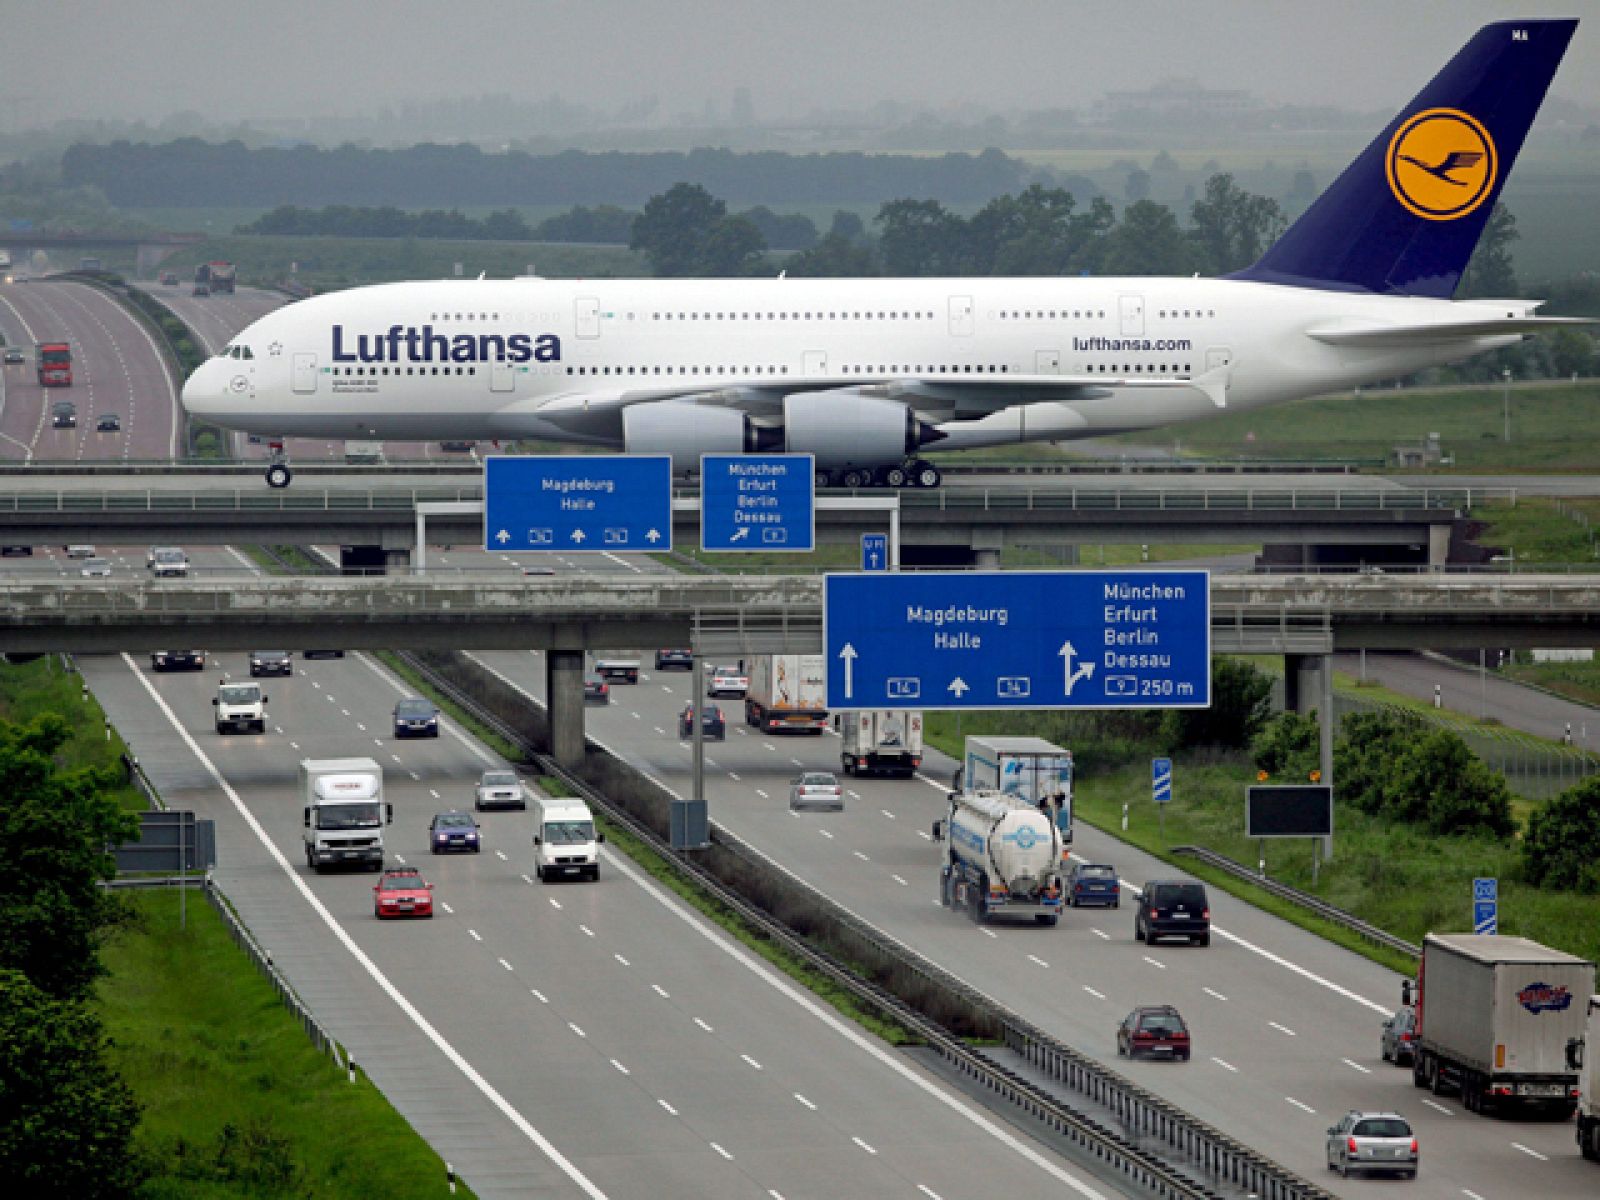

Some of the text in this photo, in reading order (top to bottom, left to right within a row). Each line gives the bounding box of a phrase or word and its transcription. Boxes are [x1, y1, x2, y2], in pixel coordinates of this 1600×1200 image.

[332, 325, 561, 362] Lufthansa
[1073, 337, 1191, 350] lufthansa.com
[730, 463, 786, 476] München
[542, 479, 614, 492] Magdeburg
[738, 479, 776, 491] Erfurt
[561, 499, 596, 510] Halle
[738, 495, 778, 507] Berlin
[735, 510, 781, 523] Dessau
[1104, 583, 1186, 599] München
[907, 605, 1009, 624] Magdeburg
[1104, 605, 1158, 622] Erfurt
[934, 632, 981, 648] Halle
[1104, 628, 1159, 646] Berlin
[1104, 651, 1171, 668] Dessau
[1141, 680, 1194, 695] 250 m
